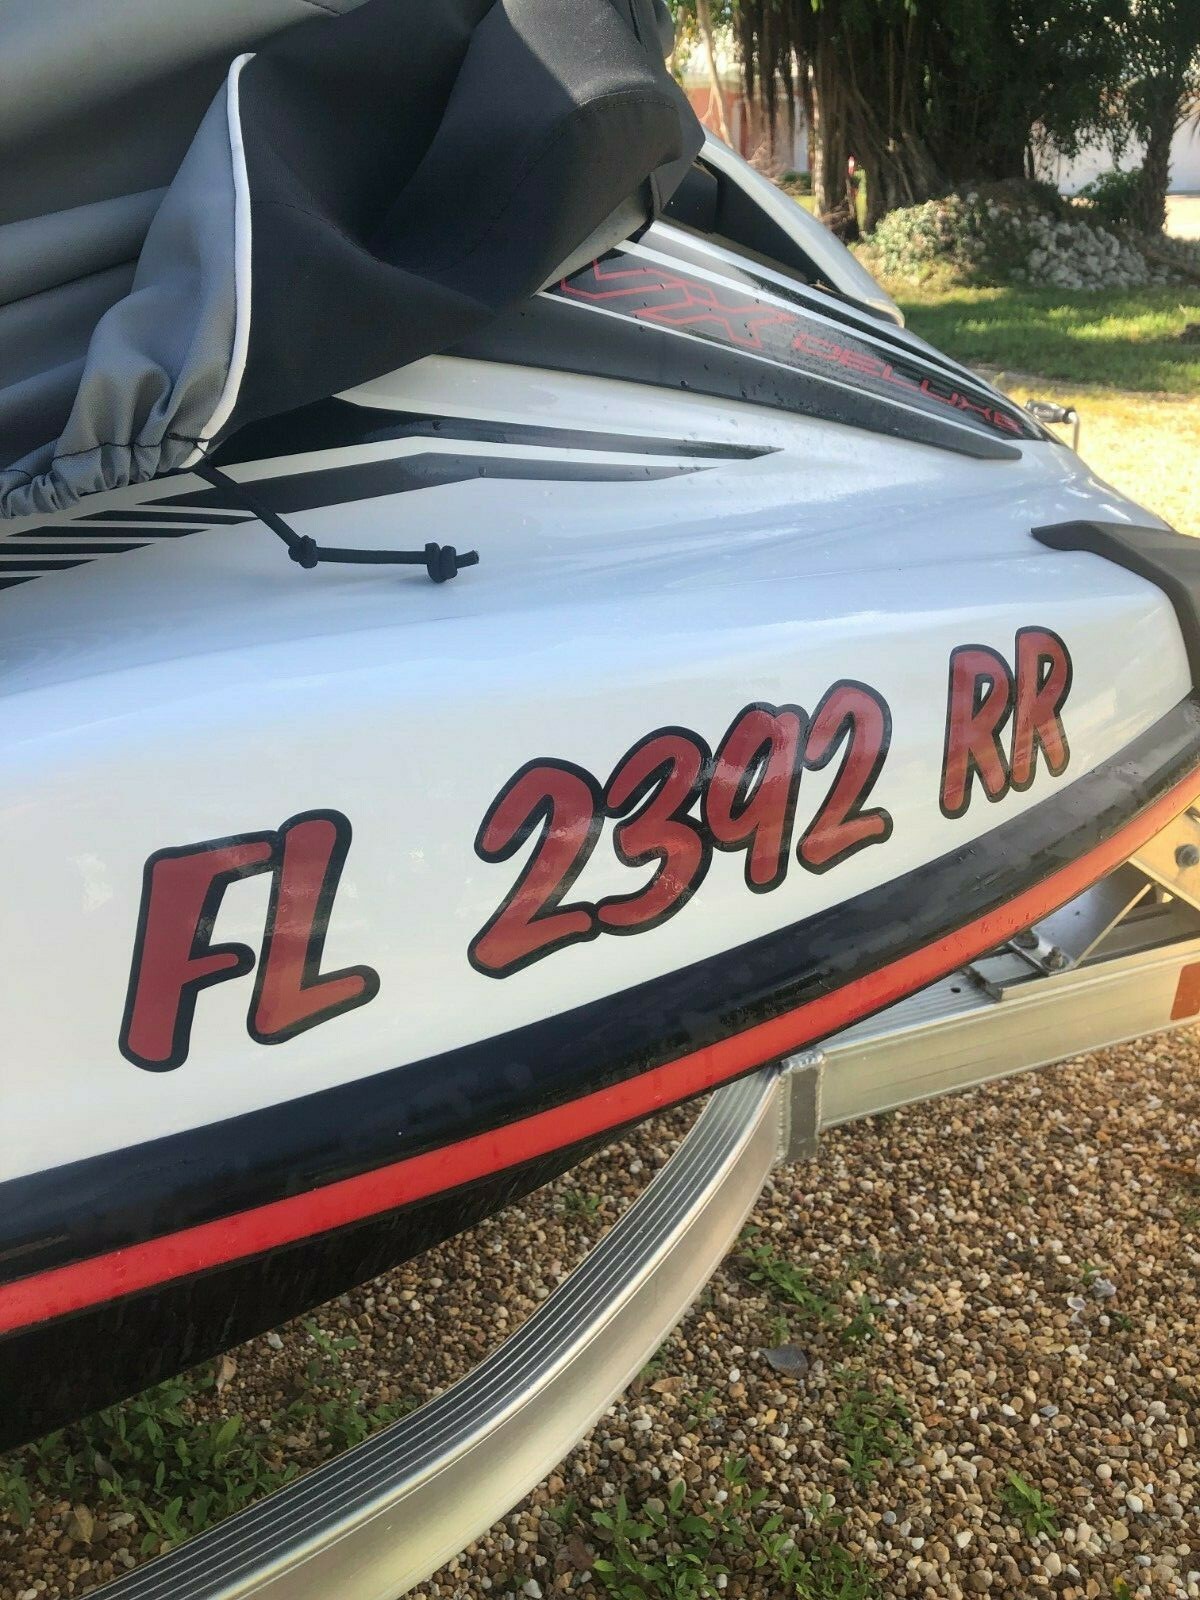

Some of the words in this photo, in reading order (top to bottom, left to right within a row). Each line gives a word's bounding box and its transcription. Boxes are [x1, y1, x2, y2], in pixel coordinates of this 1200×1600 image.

[791, 334, 1024, 434] DELUXE
[119, 808, 380, 1072] FL
[468, 679, 893, 979] 2392
[939, 626, 1072, 819] RR
